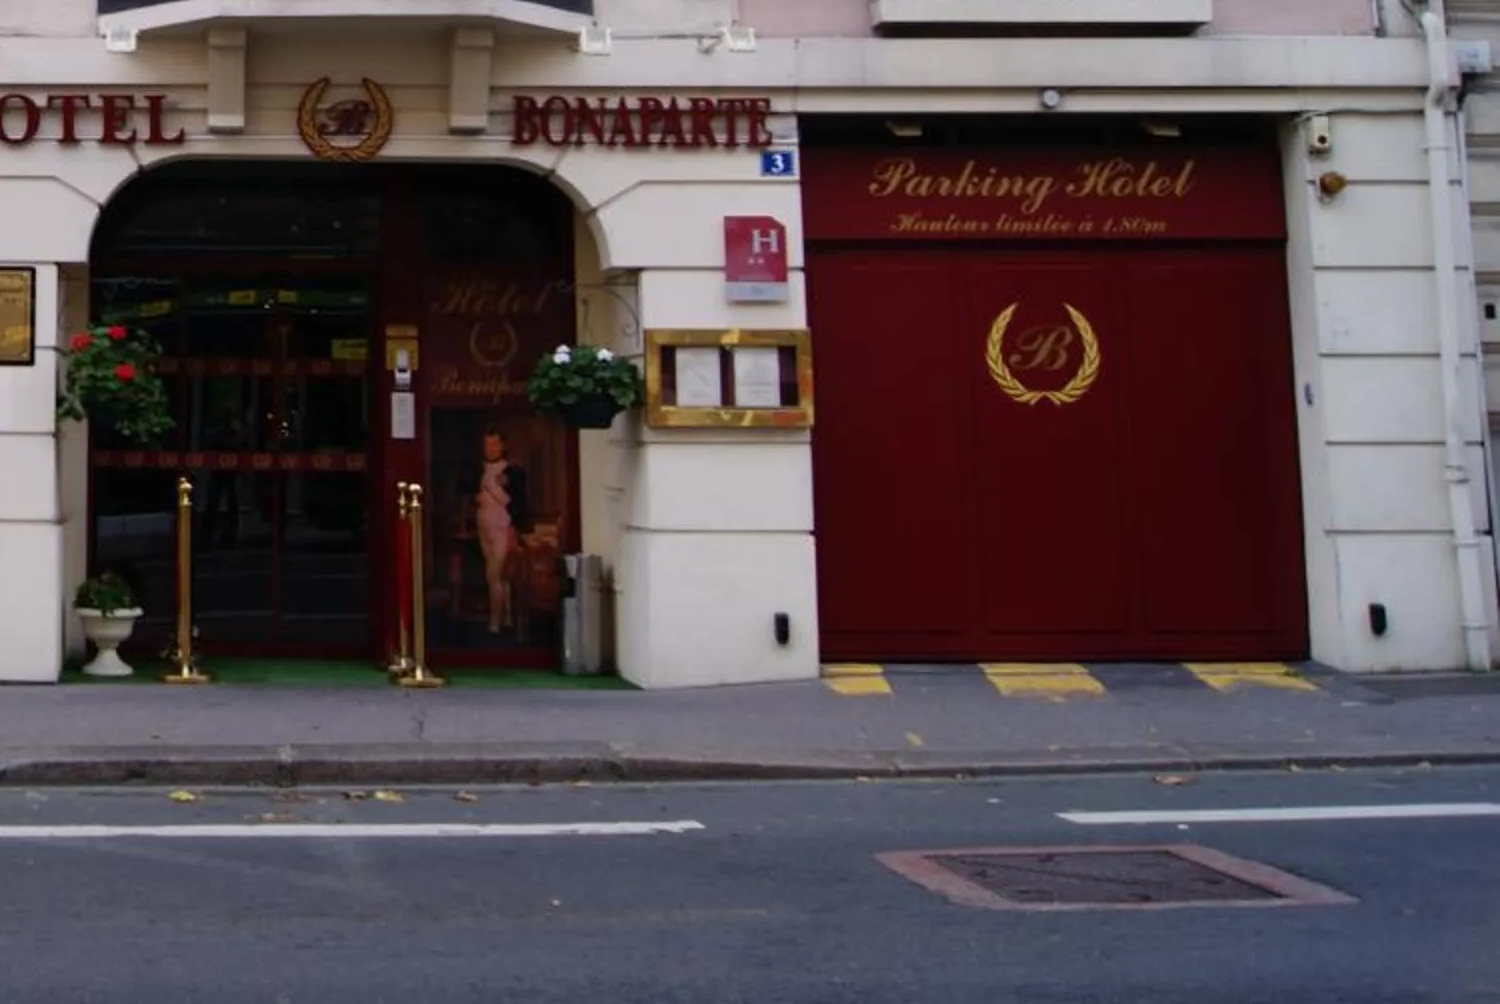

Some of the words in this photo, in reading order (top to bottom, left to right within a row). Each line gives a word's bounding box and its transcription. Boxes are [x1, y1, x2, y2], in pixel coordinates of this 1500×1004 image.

[511, 95, 773, 149] BONAPARTE
[868, 157, 1055, 214] Parking
[1065, 157, 1195, 198] Hôtel
[752, 228, 779, 255] H
[1008, 323, 1073, 371] B
